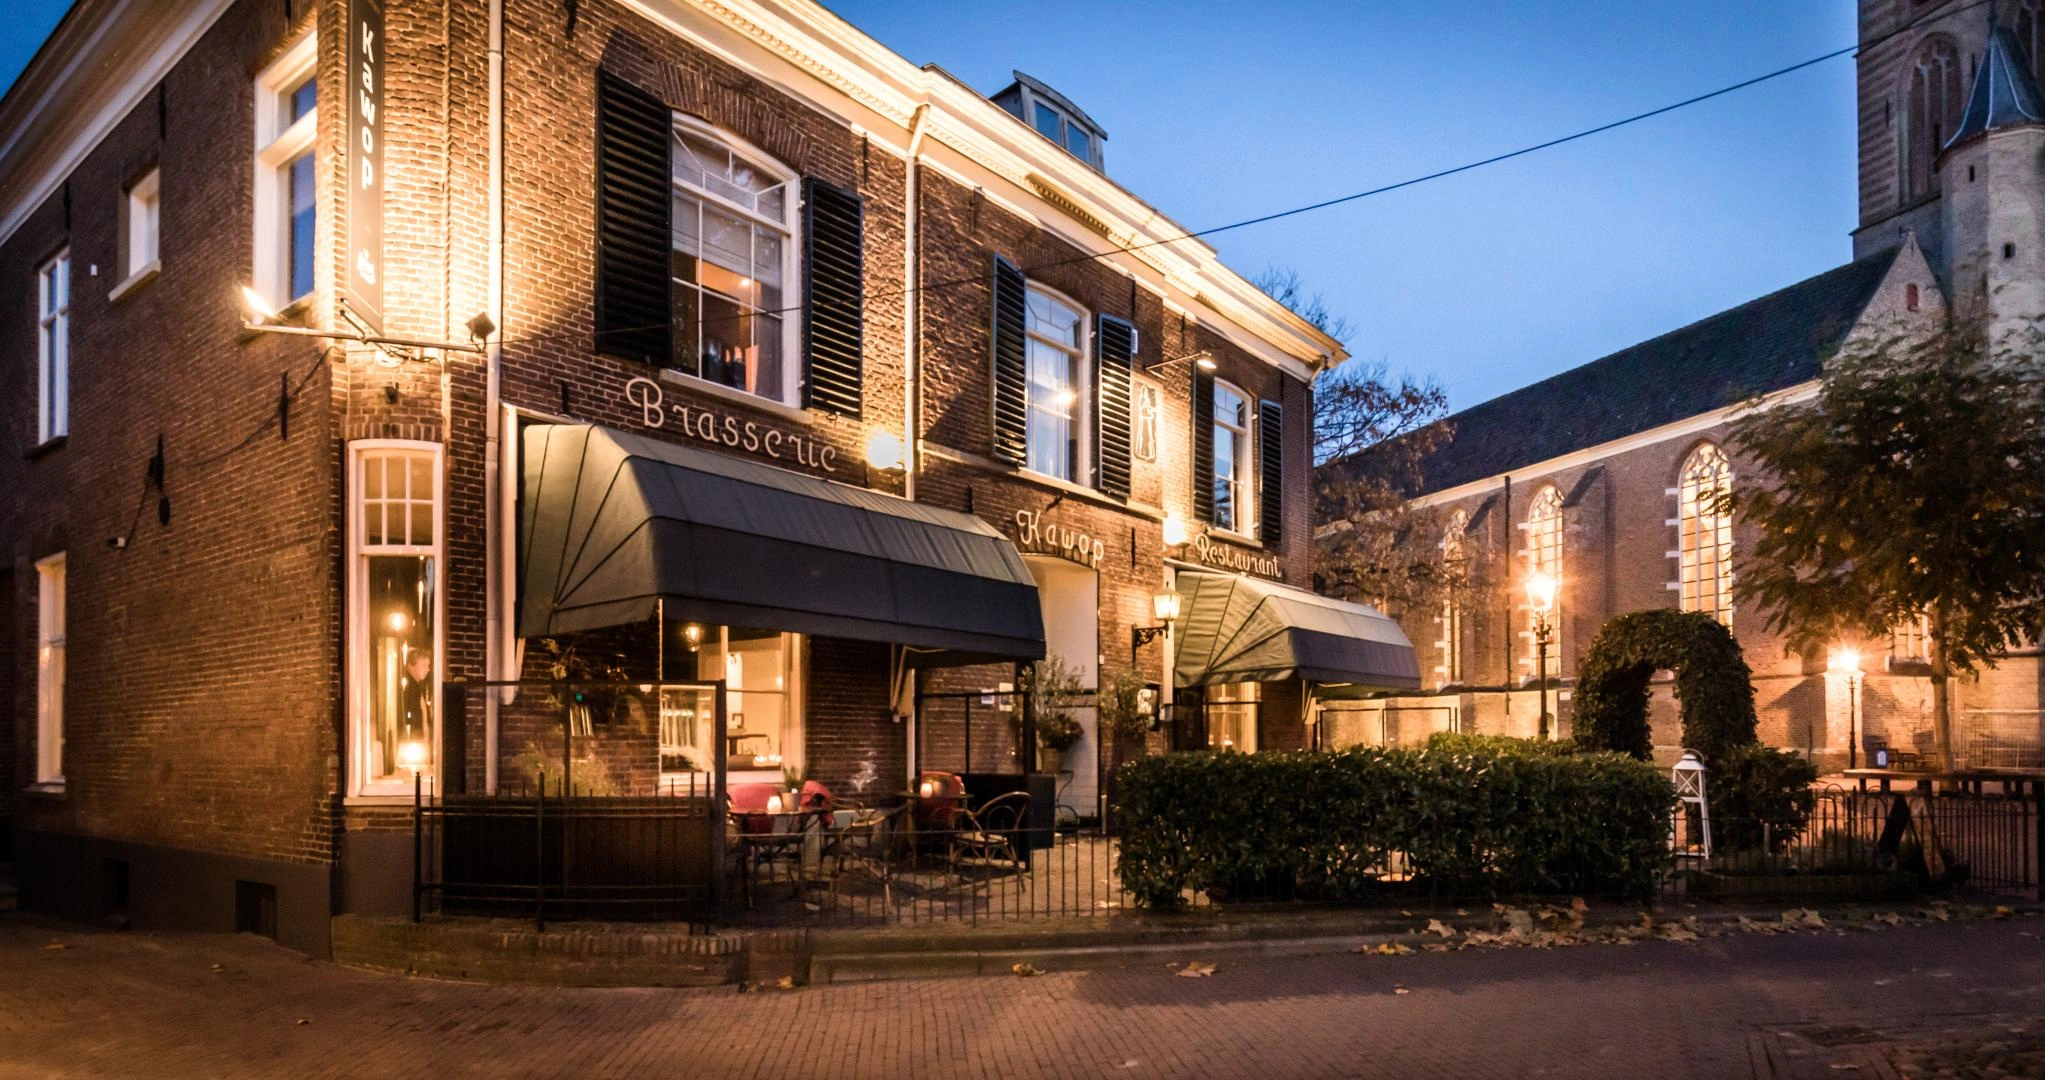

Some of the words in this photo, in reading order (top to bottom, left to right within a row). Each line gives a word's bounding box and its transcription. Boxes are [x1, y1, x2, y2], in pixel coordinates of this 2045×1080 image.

[625, 377, 836, 472] Brasserie
[1016, 509, 1105, 570] Kawop
[1195, 533, 1282, 578] Restaurant
